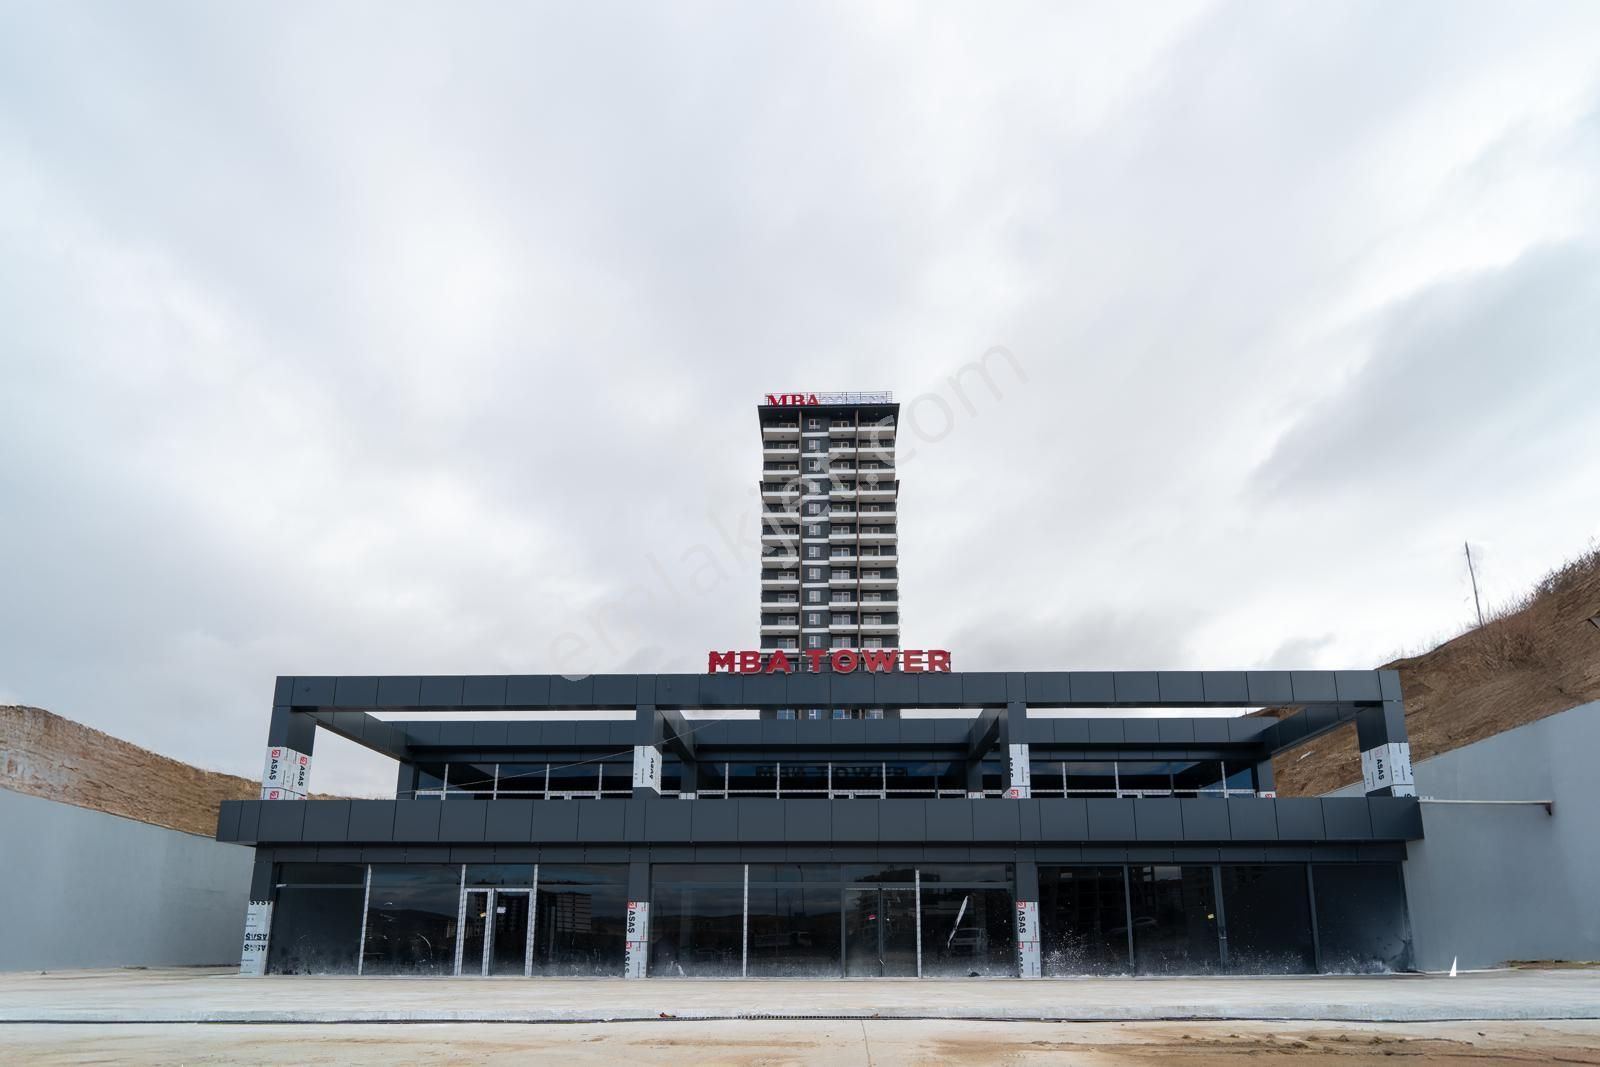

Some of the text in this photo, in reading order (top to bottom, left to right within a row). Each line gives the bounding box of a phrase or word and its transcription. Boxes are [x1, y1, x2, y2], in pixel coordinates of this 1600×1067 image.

[766, 394, 819, 407] MBA
[708, 649, 952, 675] MBA TOWER
